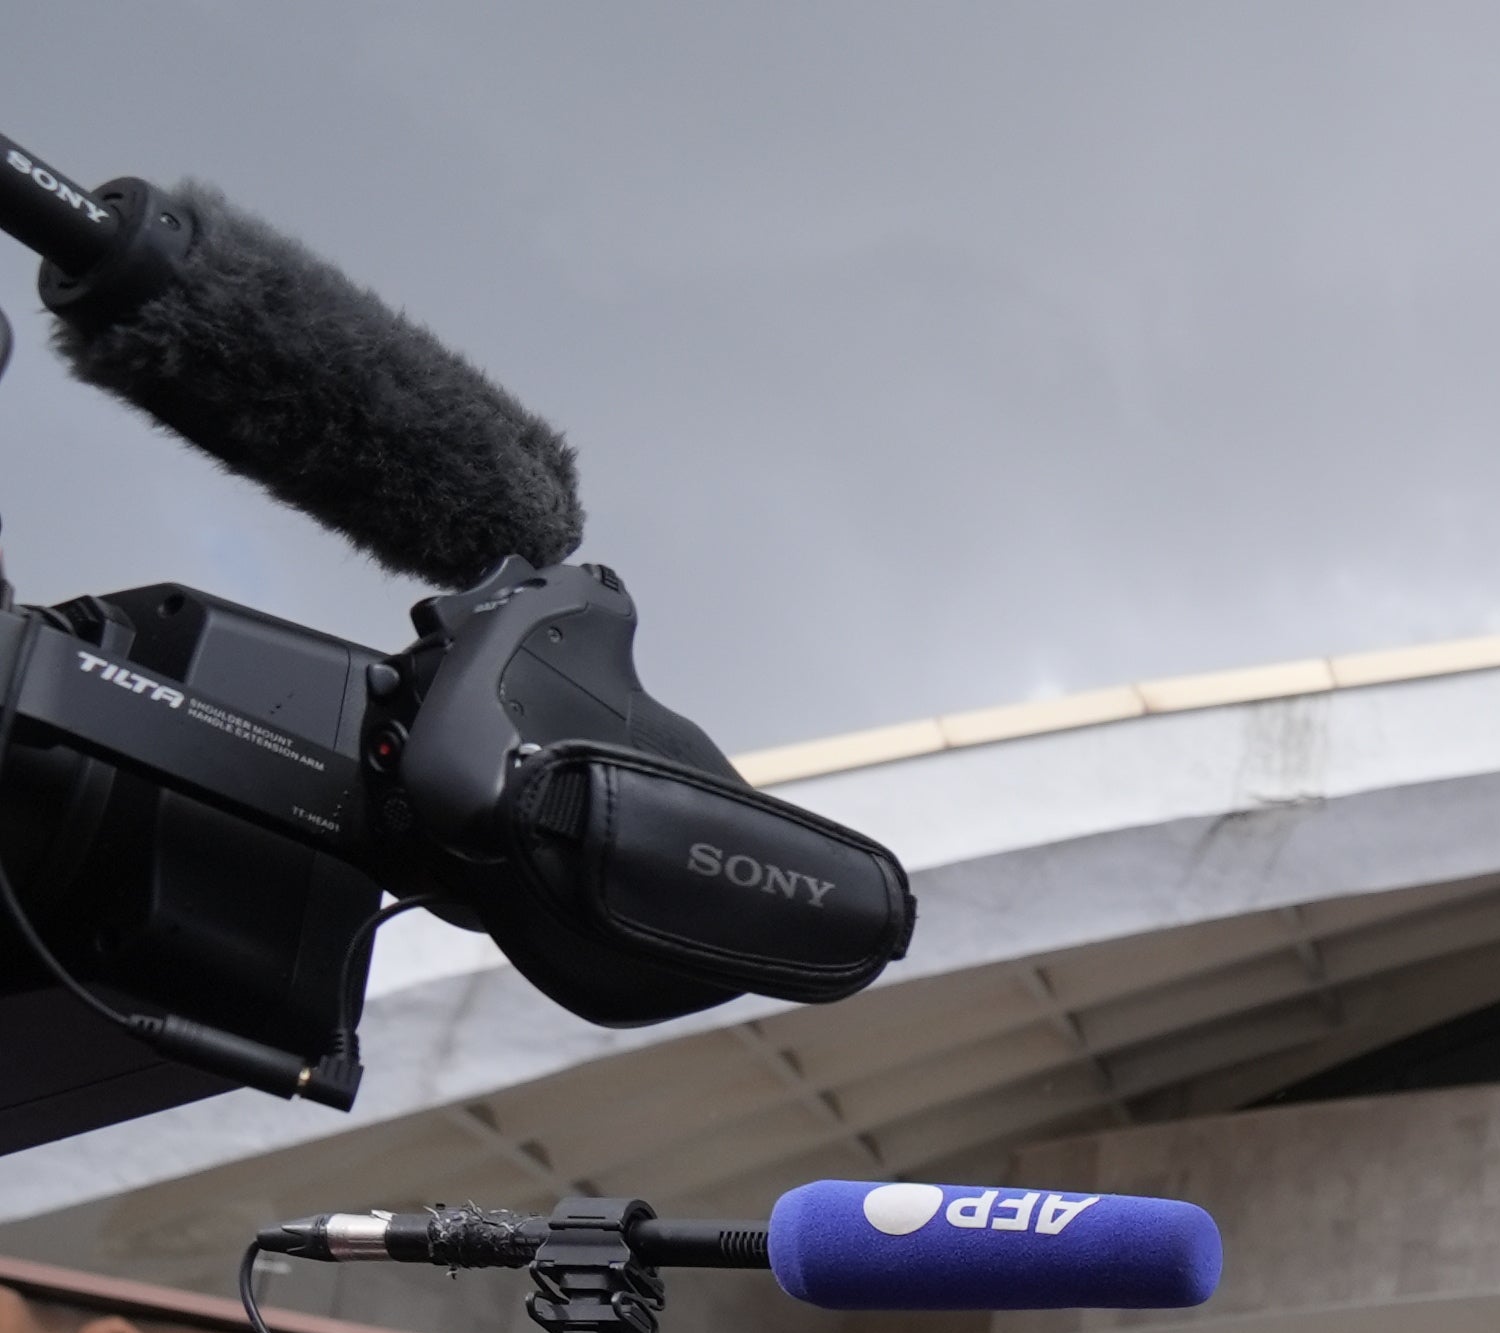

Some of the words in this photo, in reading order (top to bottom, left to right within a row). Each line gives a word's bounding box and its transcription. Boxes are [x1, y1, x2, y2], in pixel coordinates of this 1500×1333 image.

[7, 150, 109, 223] SONY
[77, 651, 184, 708] TILTA
[187, 708, 234, 734] HANDLE
[235, 727, 300, 761] EXTENSION
[299, 755, 325, 772] ARM
[189, 698, 251, 731] SHOULDER
[252, 725, 294, 748] MOUNT
[687, 843, 836, 908] SONY
[945, 1190, 1100, 1235] AFP
